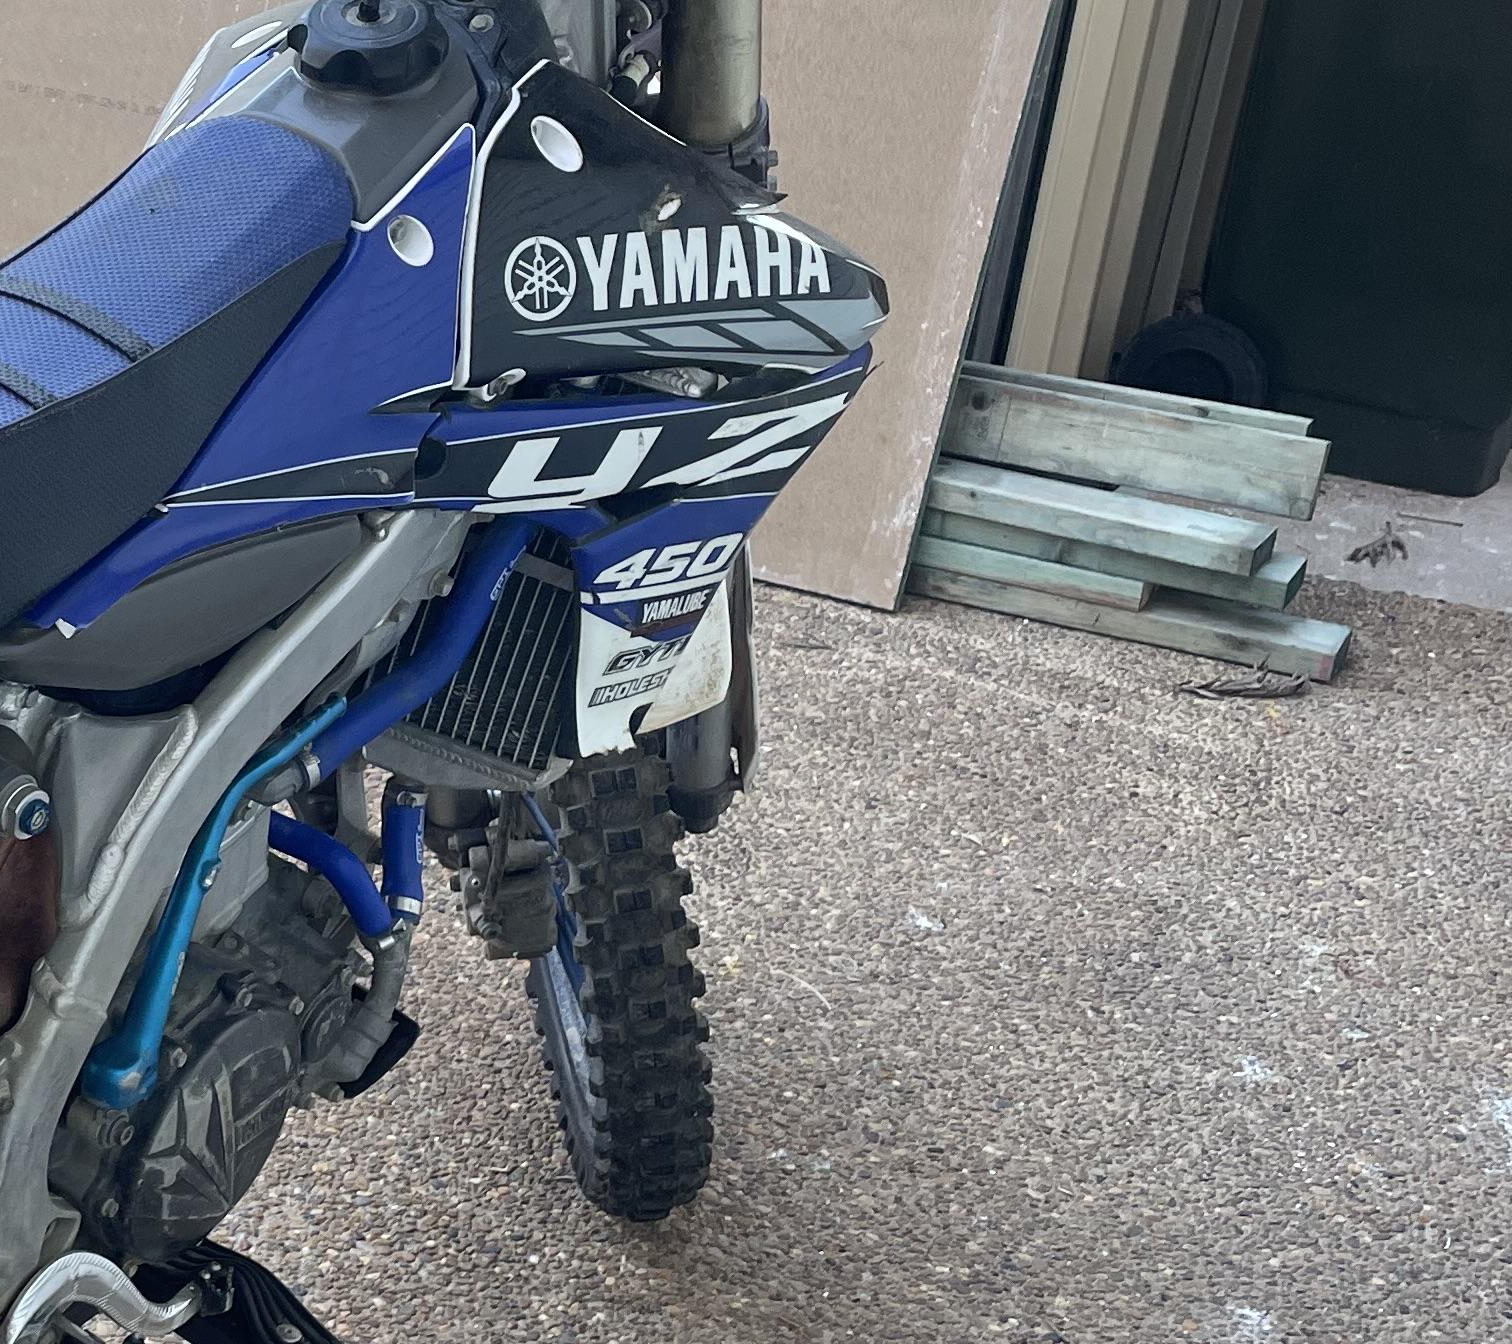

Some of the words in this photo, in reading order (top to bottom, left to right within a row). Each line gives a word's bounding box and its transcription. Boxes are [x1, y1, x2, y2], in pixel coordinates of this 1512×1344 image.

[577, 225, 831, 312] YAMAHA
[594, 532, 744, 589] 450
[641, 588, 710, 624] YAMALUBE
